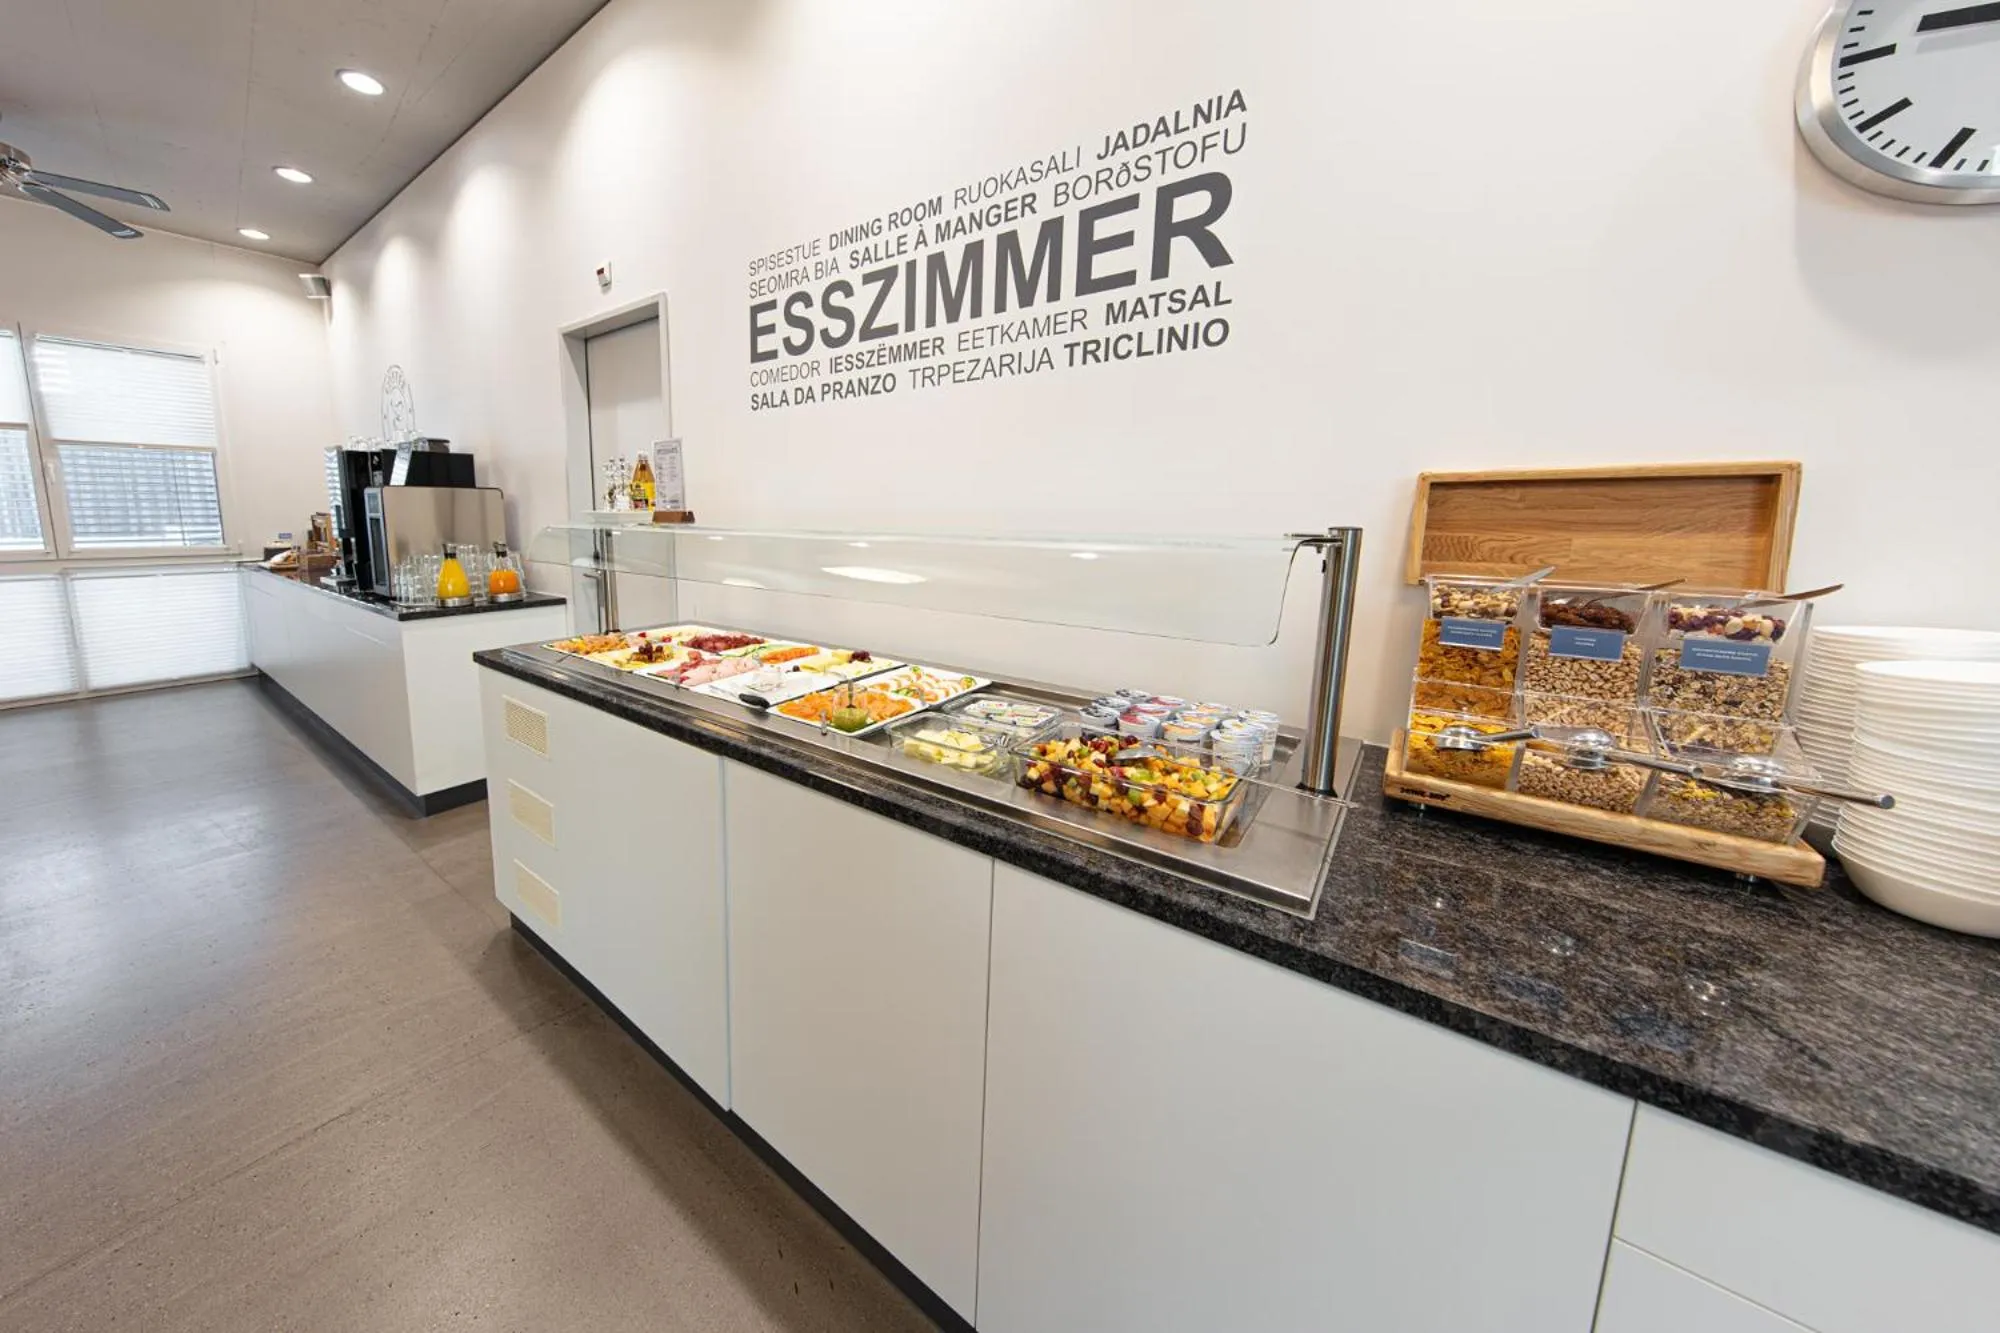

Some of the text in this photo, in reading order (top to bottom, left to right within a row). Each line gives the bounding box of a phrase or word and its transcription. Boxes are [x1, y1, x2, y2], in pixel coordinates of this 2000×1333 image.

[748, 89, 1248, 276] SPISESTUE DINING ROOM RUOKASALI JADALNIA
[749, 266, 811, 300] SEOMRA
[814, 256, 840, 281] BIA
[849, 234, 909, 270] SALLE
[913, 223, 929, 251] À
[934, 193, 1038, 245] MANGER
[749, 171, 1235, 365] ESSZIMMER
[750, 281, 1233, 388] COMEDOR IESSZËMMER EETKAMER MATSAL
[750, 318, 1230, 412] SALA DA PRANZO TRPEZARIJA TRICLINIO
